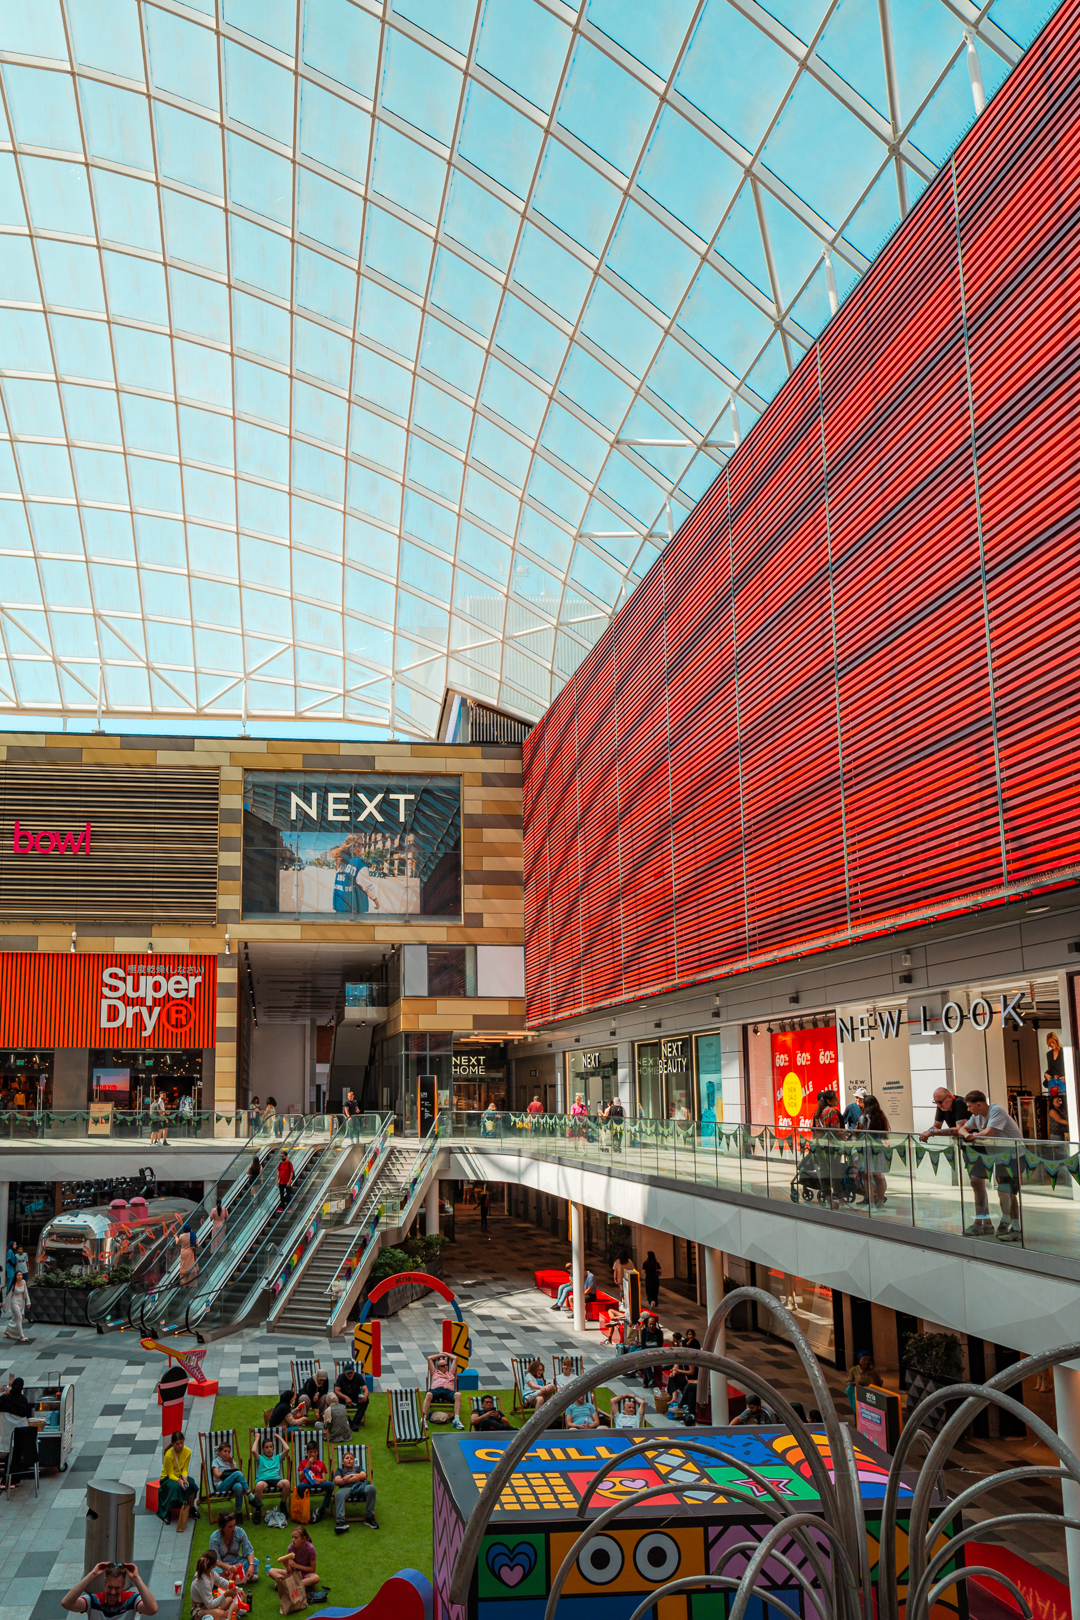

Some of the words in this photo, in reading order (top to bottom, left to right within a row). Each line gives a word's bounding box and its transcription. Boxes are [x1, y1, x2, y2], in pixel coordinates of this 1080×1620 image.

[290, 791, 415, 823] NEXT
[13, 820, 91, 854] bowl
[101, 967, 202, 1006] Super
[838, 1009, 902, 1043] NEW
[920, 993, 1025, 1036] LOOK
[661, 1041, 683, 1057] NEXT
[452, 1056, 486, 1065] NEXT
[582, 1052, 600, 1068] NEXT
[658, 1057, 687, 1074] BEAUTY
[452, 1066, 486, 1075] HOME
[394, 1275, 412, 1285] atria
